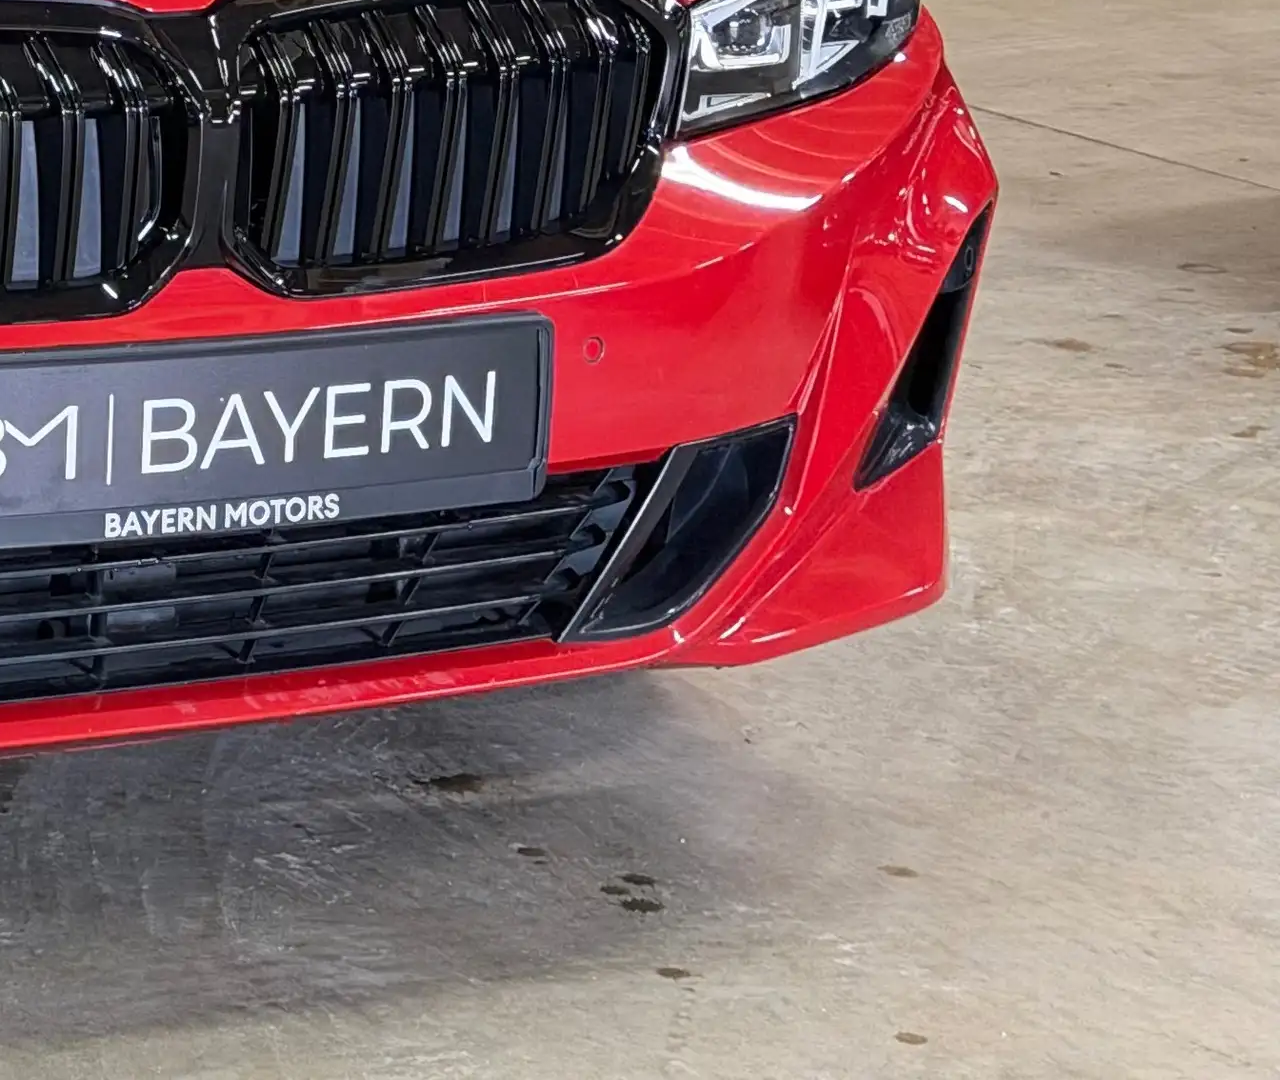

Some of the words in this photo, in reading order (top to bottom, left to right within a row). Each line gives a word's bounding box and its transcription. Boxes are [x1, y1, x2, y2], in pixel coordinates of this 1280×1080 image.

[140, 370, 496, 475] BAYERN
[104, 504, 217, 539] BAYERN
[224, 493, 340, 529] MOTORS
